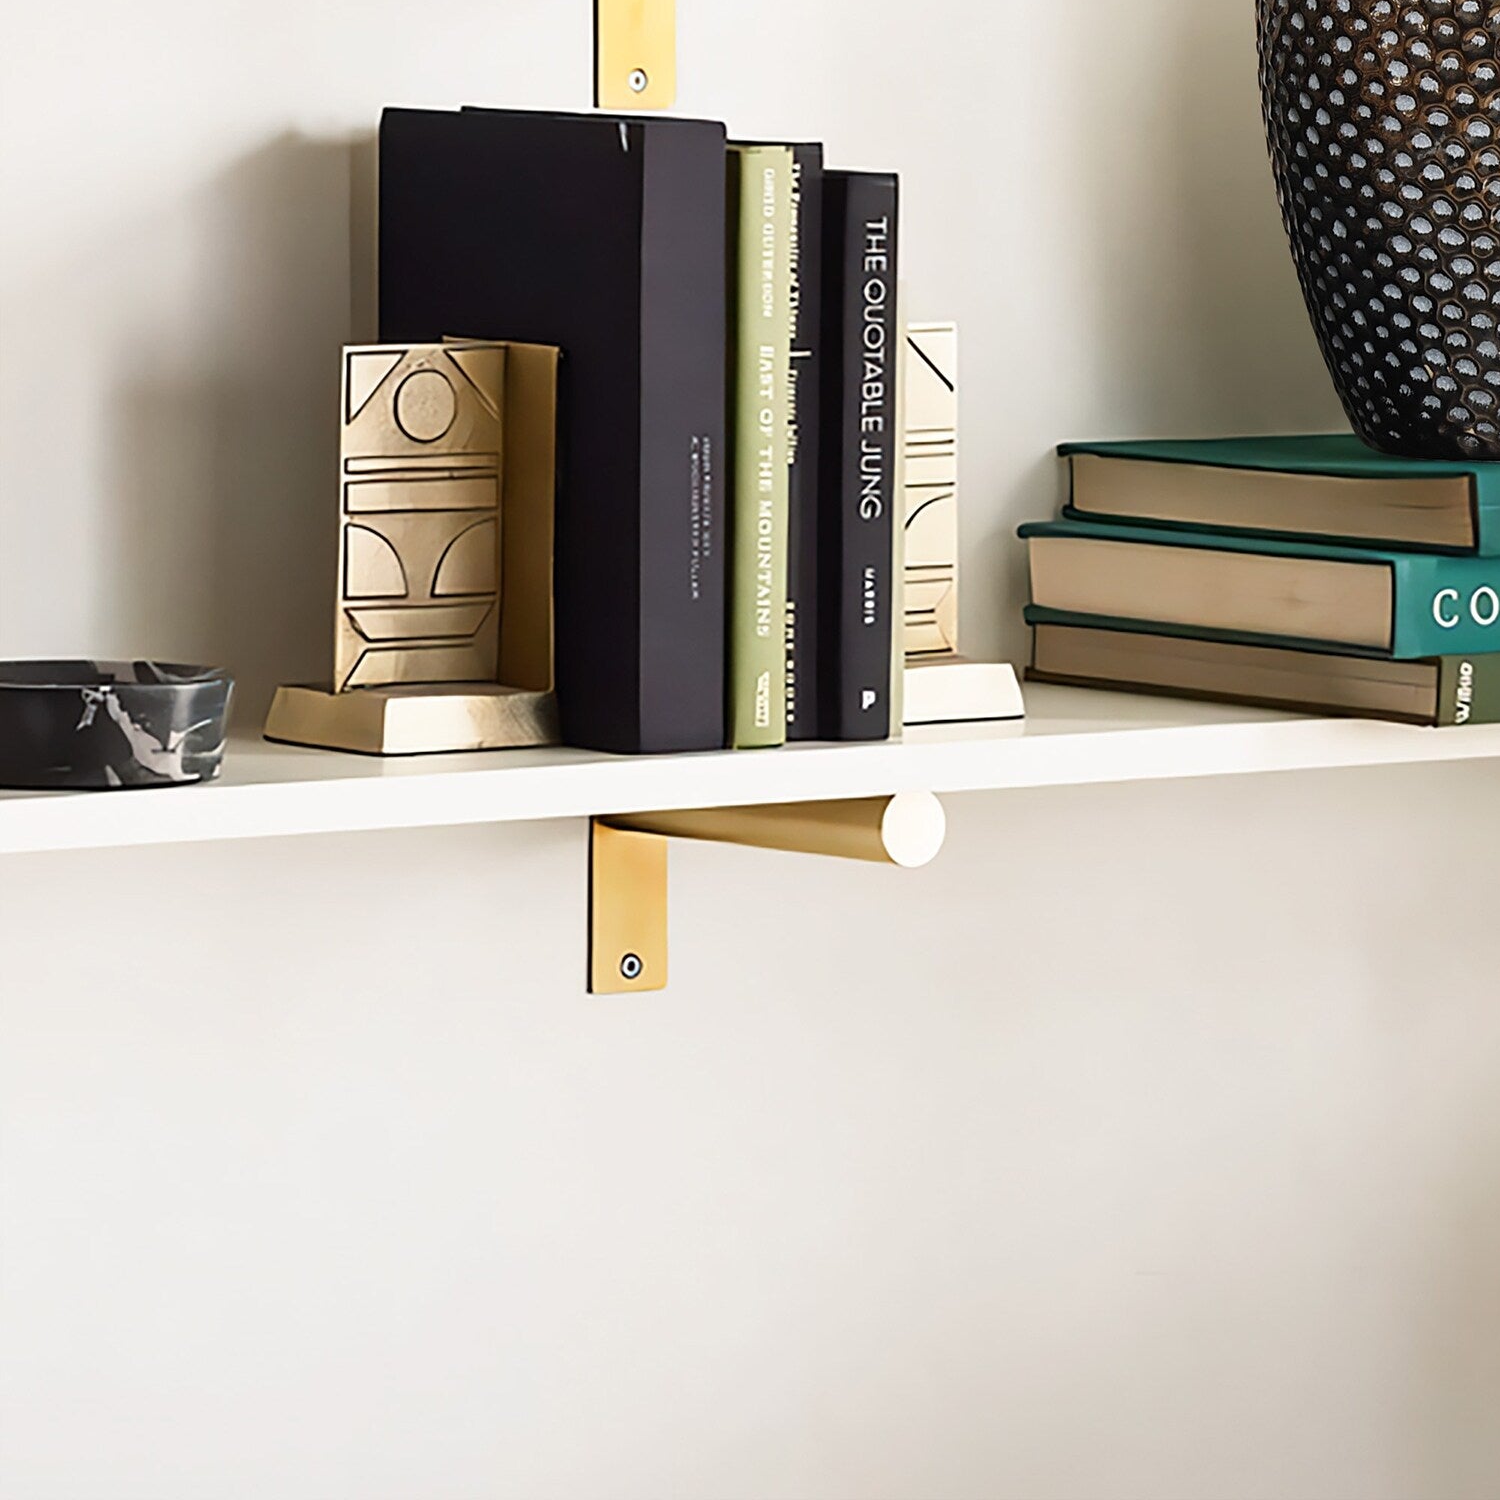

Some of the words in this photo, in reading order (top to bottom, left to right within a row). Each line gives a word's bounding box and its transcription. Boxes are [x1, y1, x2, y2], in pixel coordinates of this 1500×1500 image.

[864, 216, 888, 273] THE
[860, 278, 887, 433] QUOTABLE
[758, 445, 774, 493] THE
[858, 439, 884, 521] JUNG
[756, 499, 773, 638] MOUNTAINS
